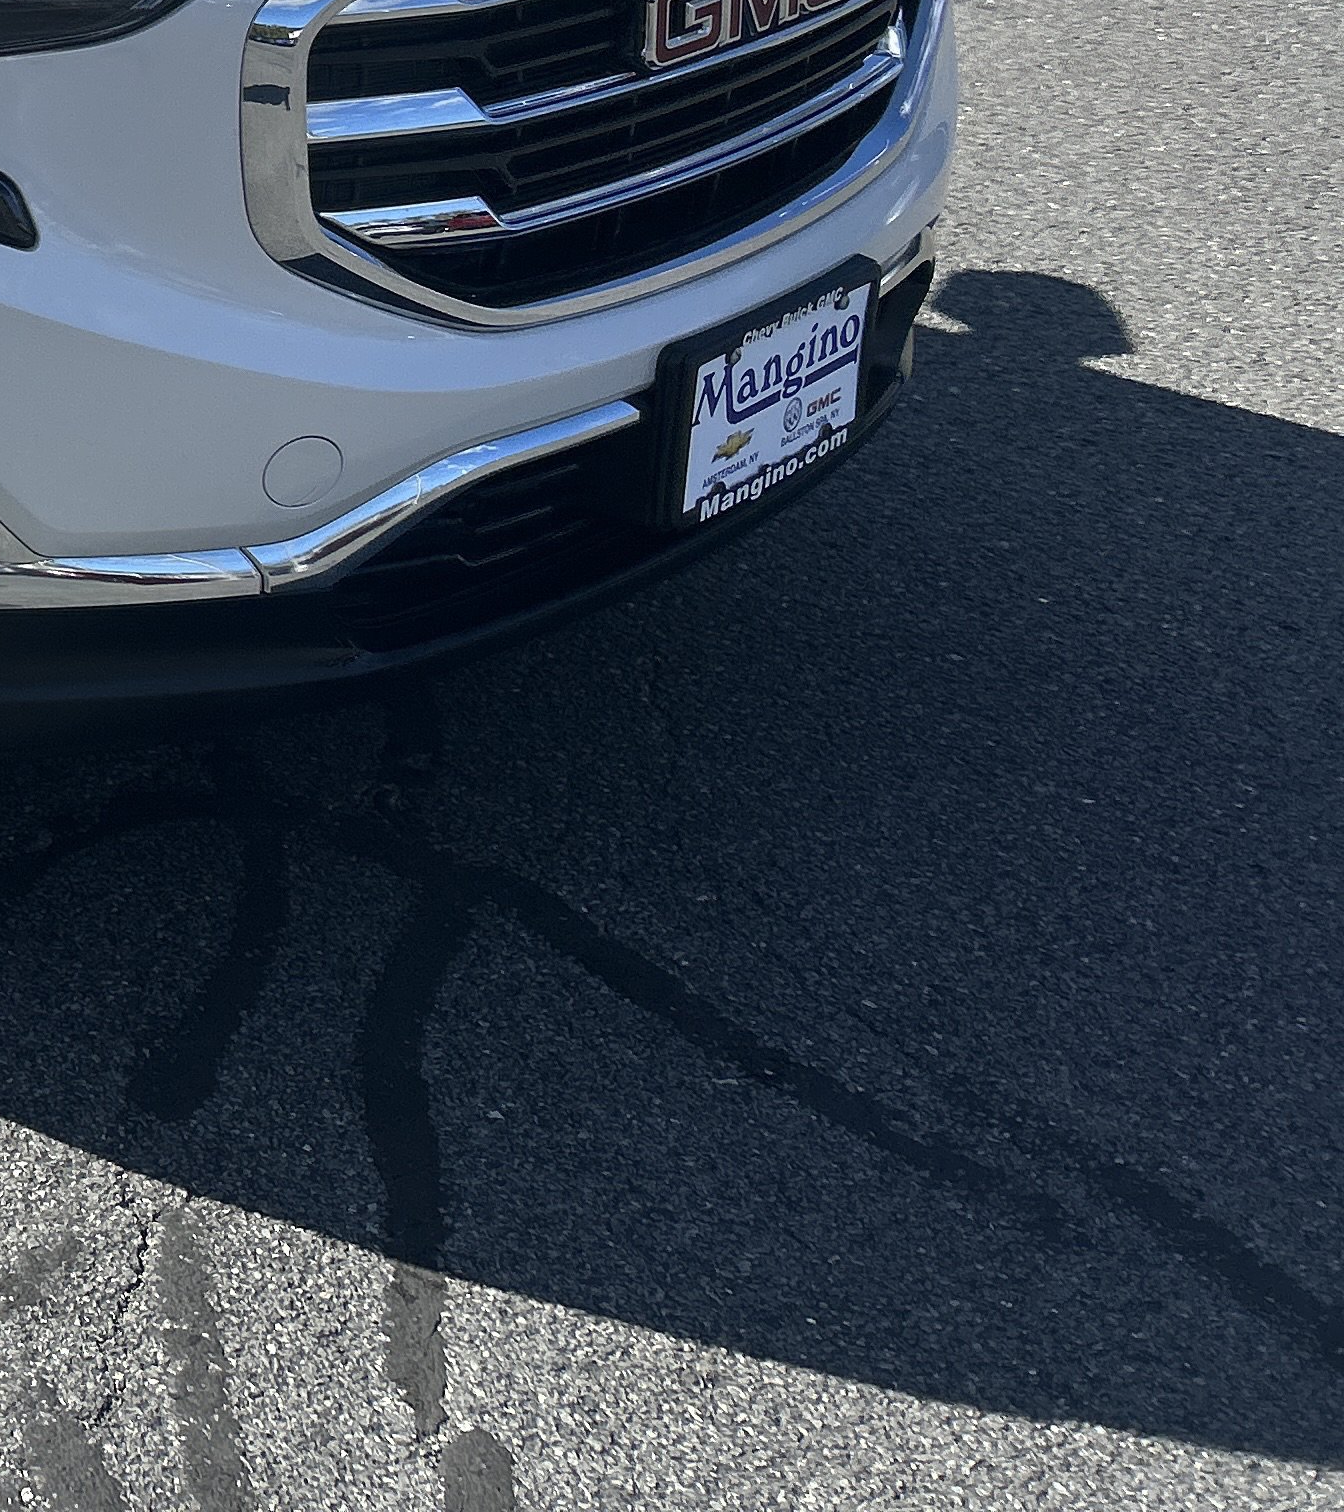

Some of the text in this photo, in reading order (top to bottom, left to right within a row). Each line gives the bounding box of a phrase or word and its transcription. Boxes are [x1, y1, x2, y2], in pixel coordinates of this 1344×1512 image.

[743, 286, 844, 345] Chevy Buick GMC
[691, 314, 861, 426] Mangino
[807, 387, 842, 418] GMC
[699, 428, 849, 523] Mangino.com
